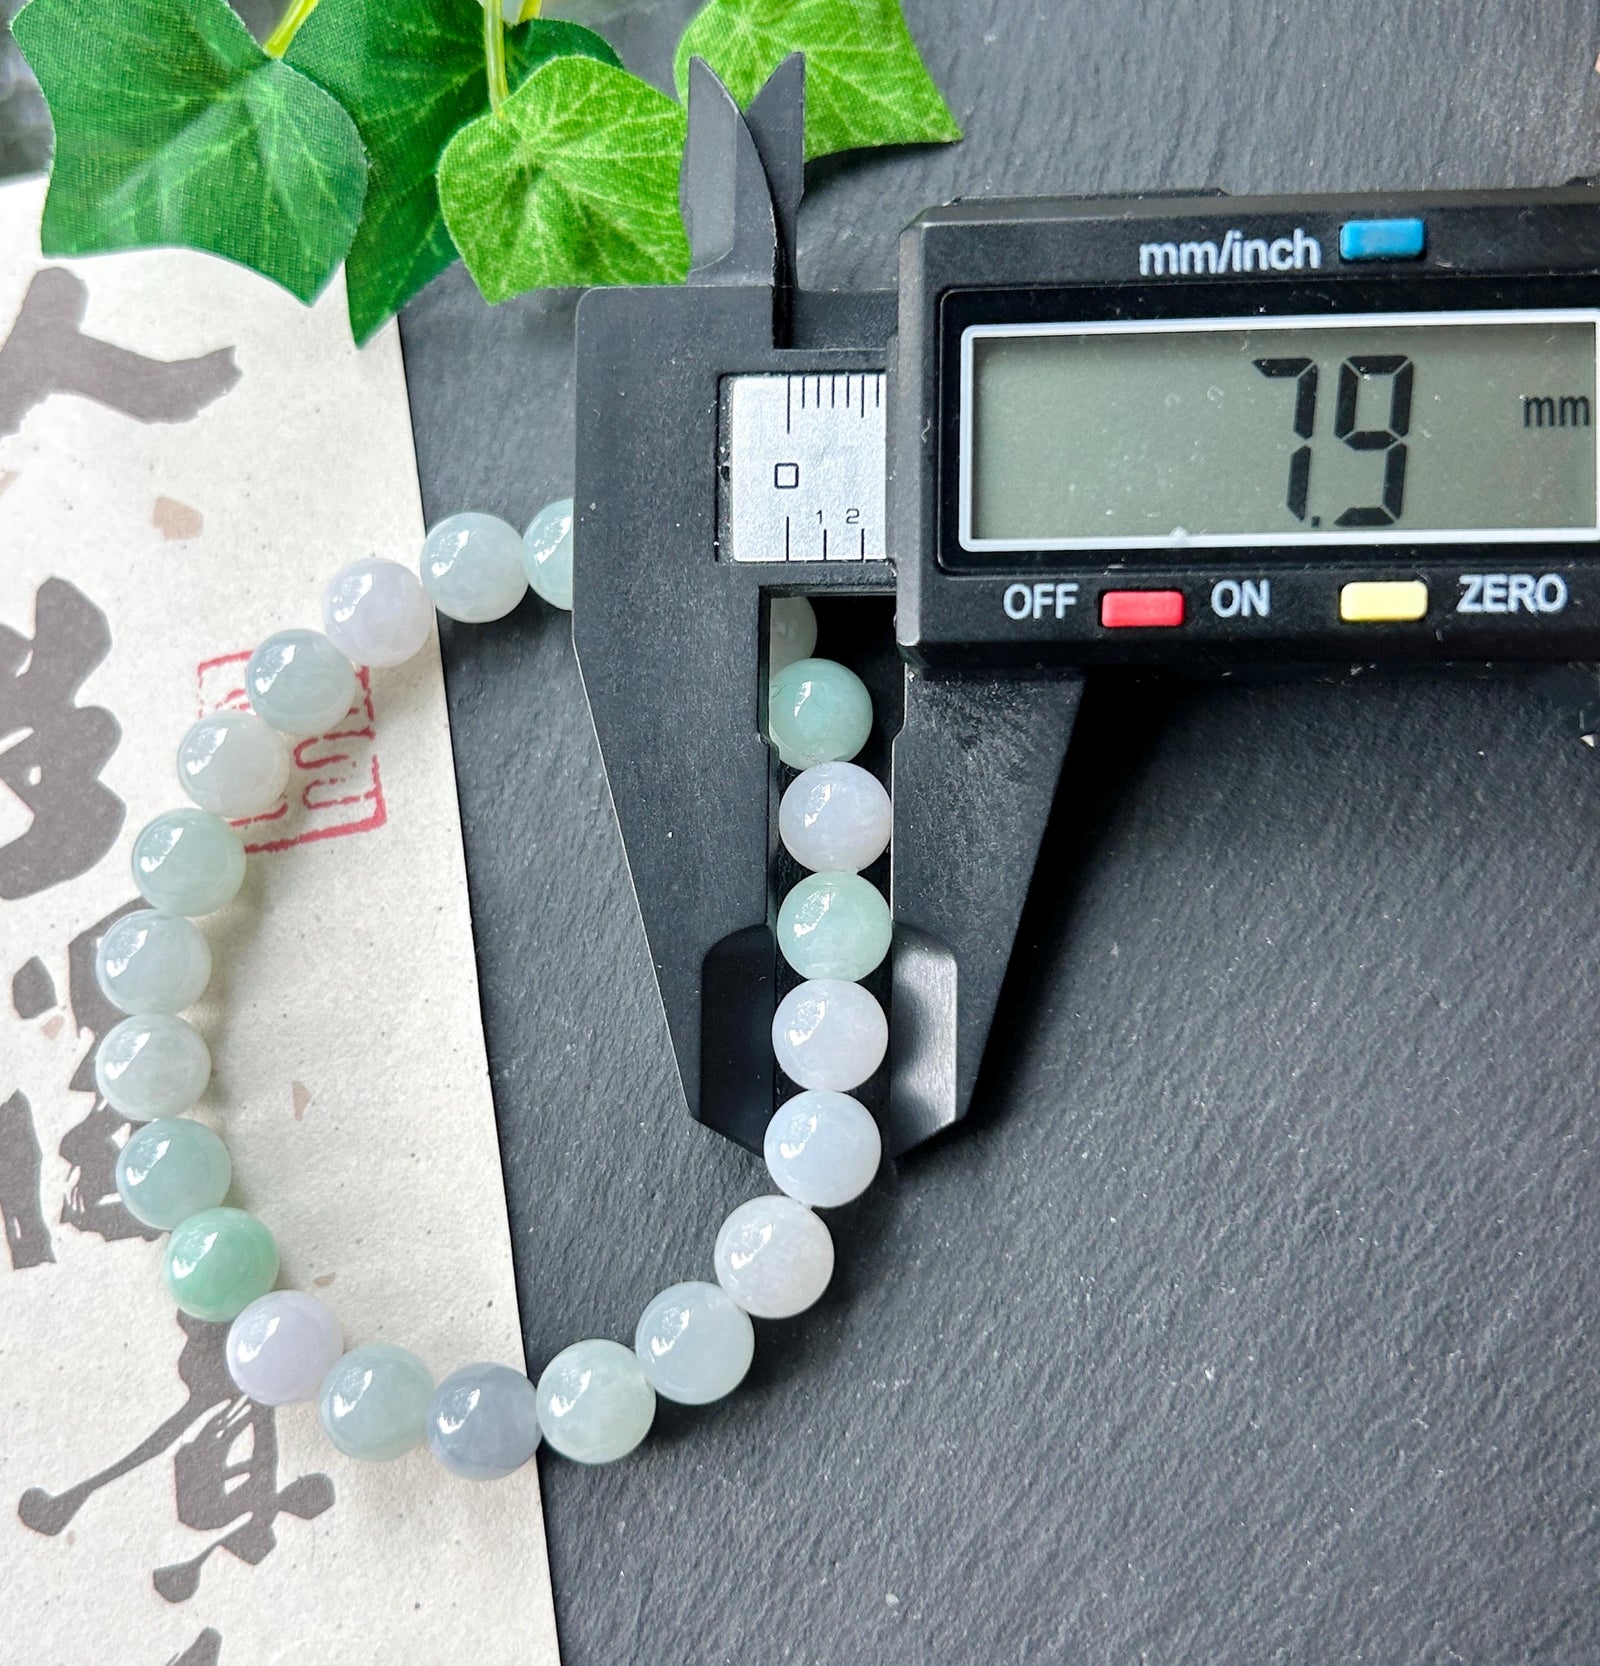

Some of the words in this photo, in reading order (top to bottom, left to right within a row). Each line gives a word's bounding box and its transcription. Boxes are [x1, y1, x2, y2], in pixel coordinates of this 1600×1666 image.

[1138, 228, 1321, 277] mm/inch
[1252, 353, 1414, 527] 7.9
[1522, 393, 1590, 428] mm
[816, 509, 824, 525] 1
[845, 508, 860, 524] 2
[1002, 582, 1080, 621] OFF
[1210, 579, 1271, 618] ON
[1456, 573, 1568, 615] ZERO
